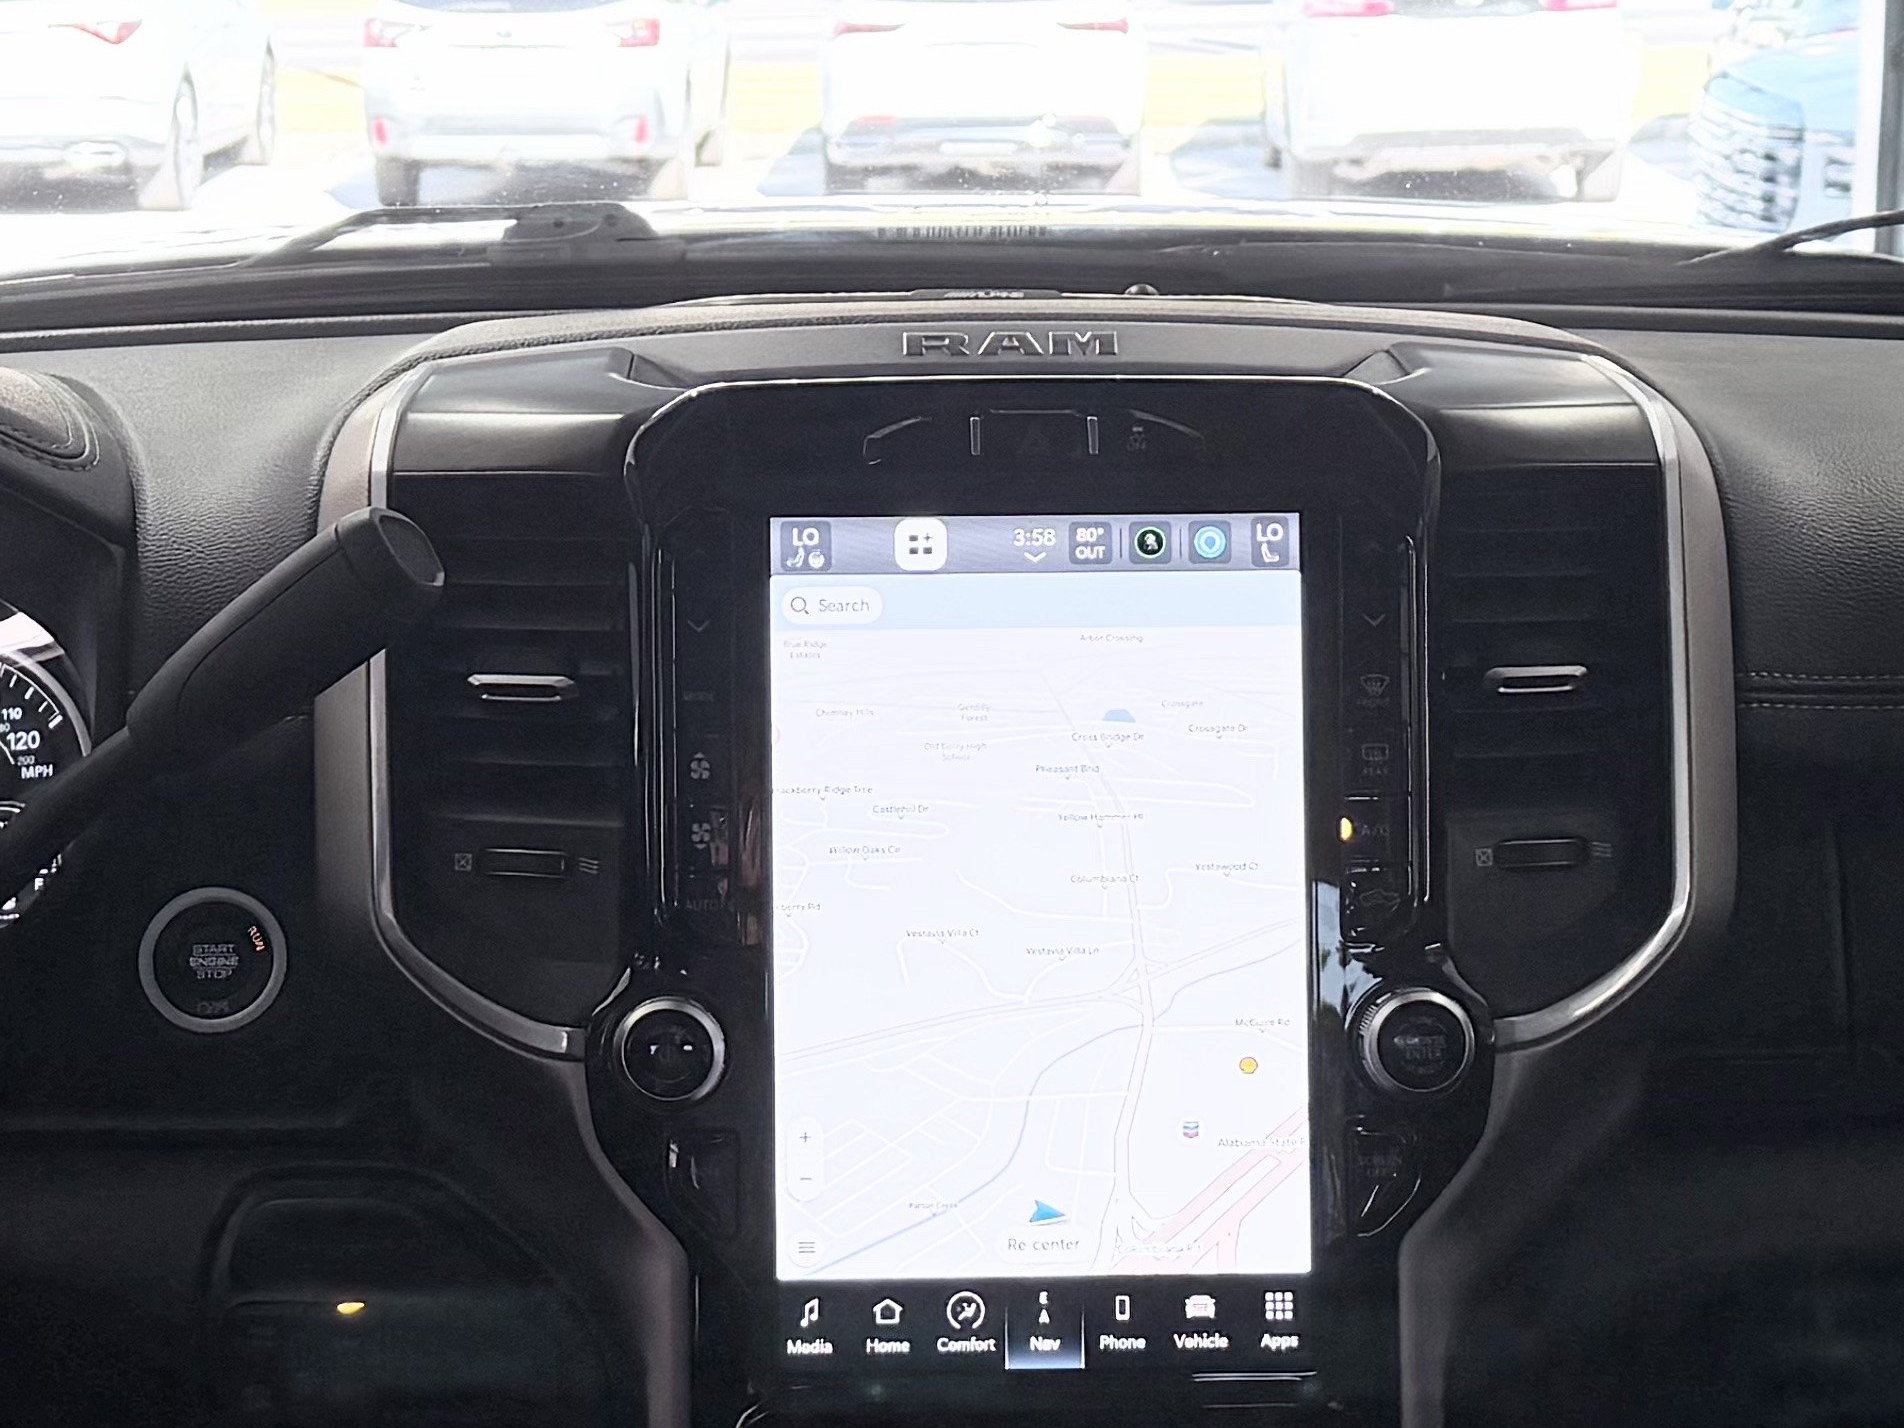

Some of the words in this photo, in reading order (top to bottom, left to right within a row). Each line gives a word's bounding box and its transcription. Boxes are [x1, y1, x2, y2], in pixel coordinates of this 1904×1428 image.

[902, 331, 1118, 356] RAM
[793, 528, 820, 547] LO
[1013, 528, 1056, 547] 3:58
[1256, 523, 1283, 542] LO
[1076, 546, 1105, 559] OUT
[818, 598, 871, 613] Search
[1, 706, 23, 720] 110
[6, 730, 41, 751] 120
[1071, 732, 1098, 742] Cross
[20, 763, 54, 780] MPH
[192, 943, 236, 956] START
[188, 956, 240, 968] ENGINE
[787, 1339, 834, 1354] Media
[866, 1338, 911, 1354] Home
[937, 1337, 996, 1353] Comfort
[1030, 1336, 1061, 1352] Nav
[1099, 1334, 1147, 1350] Phone
[1173, 1332, 1230, 1350] Vehicle
[1260, 1333, 1300, 1352] Apps
